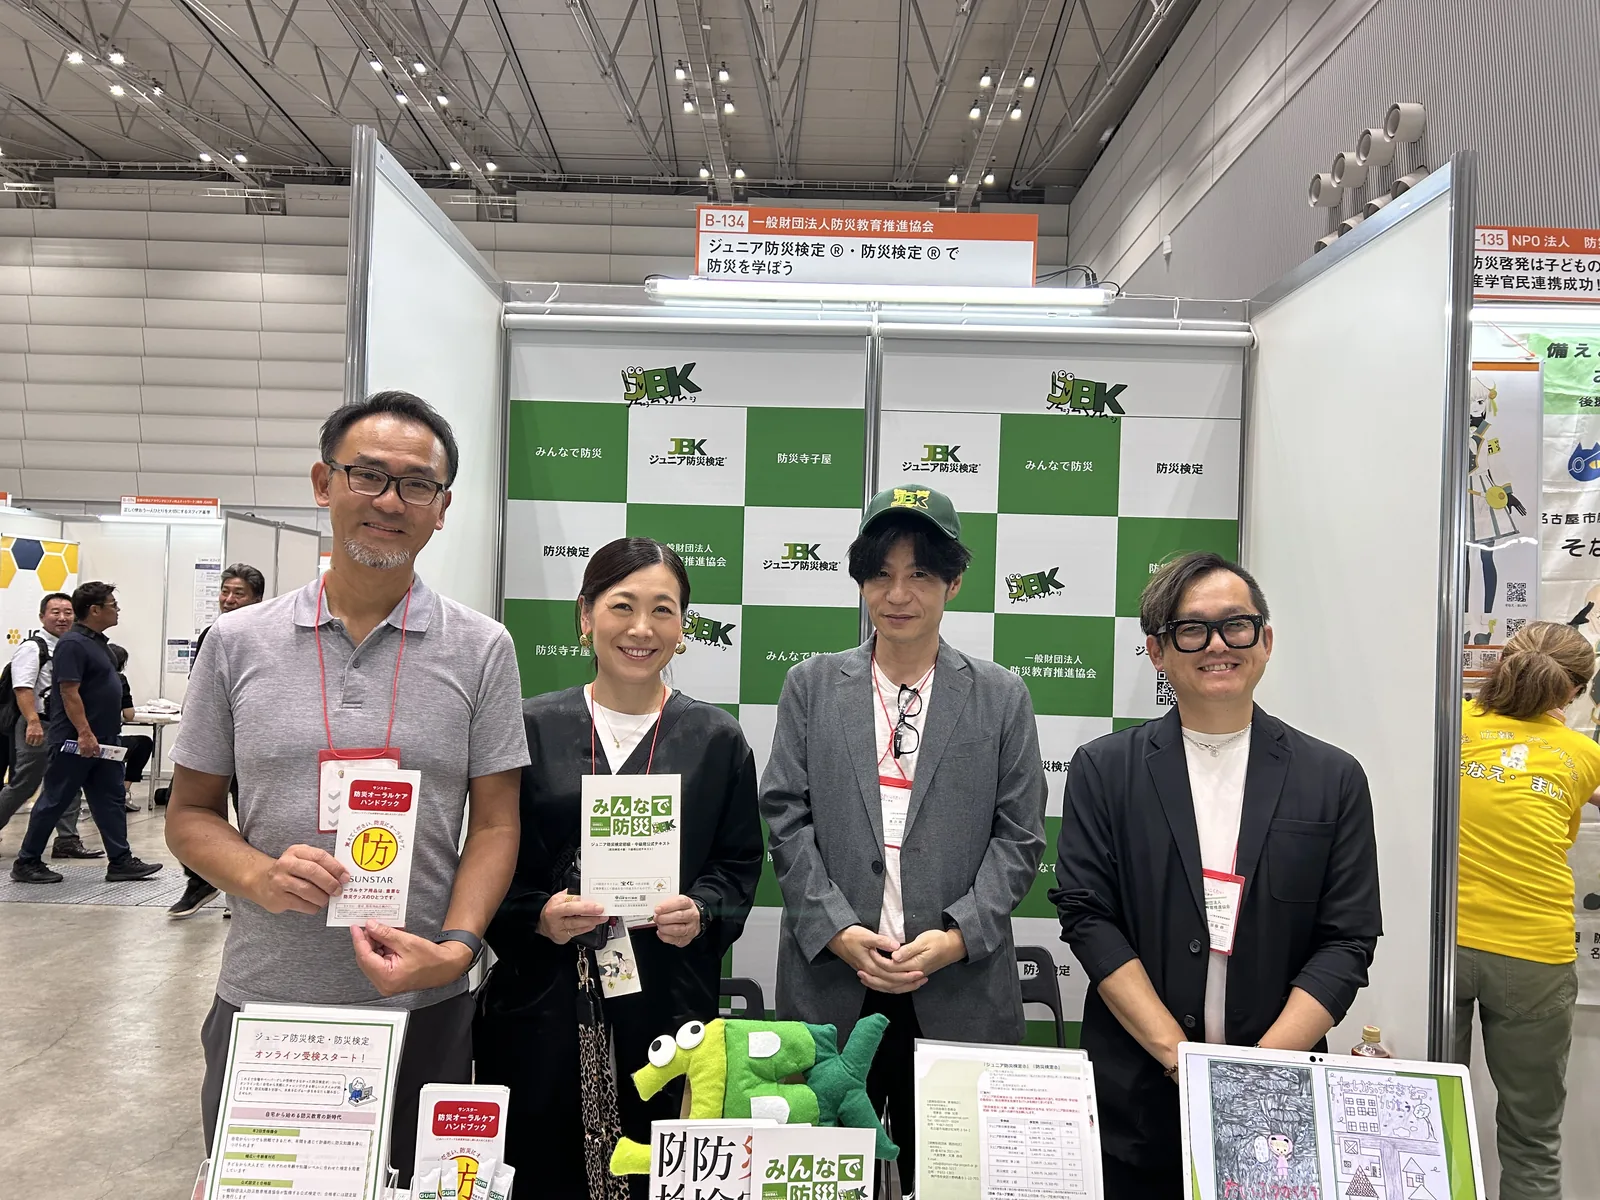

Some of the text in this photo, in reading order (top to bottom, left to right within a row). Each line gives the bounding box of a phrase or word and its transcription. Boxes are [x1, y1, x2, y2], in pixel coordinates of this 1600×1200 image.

[705, 213, 935, 234] B-134 一般財団法人防災教育推進協会
[1512, 235, 1541, 247] NPO
[1544, 235, 1570, 248] 法人
[1584, 236, 1600, 250] 防
[707, 258, 794, 276] 防災を学ぼう
[1547, 342, 1600, 359] 備え
[622, 362, 702, 402] JBK
[1047, 370, 1129, 415] JBK
[535, 446, 603, 459] みんなで防災
[667, 437, 708, 456] JBK
[920, 444, 961, 463] JBK
[777, 452, 832, 465] 防災寺子屋
[1024, 459, 1094, 473] みんなで防災
[1156, 462, 1204, 476] 防災検定
[543, 545, 590, 558] 防災検定
[781, 542, 821, 561] JBK
[1005, 567, 1066, 602] JBK
[535, 644, 591, 658] 防災寺子屋
[1024, 653, 1083, 665] 一般財団法人
[1009, 665, 1097, 679] 防災教育推進協会
[1531, 775, 1564, 801] まい
[592, 797, 670, 815] みんなで
[612, 817, 651, 836] 防災
[255, 1032, 371, 1046] ジュニア防災検定・防災検定
[437, 1113, 496, 1123] 防災オーラルケア
[445, 1123, 487, 1132] ハンドブック
[765, 1157, 861, 1180] みんなで
